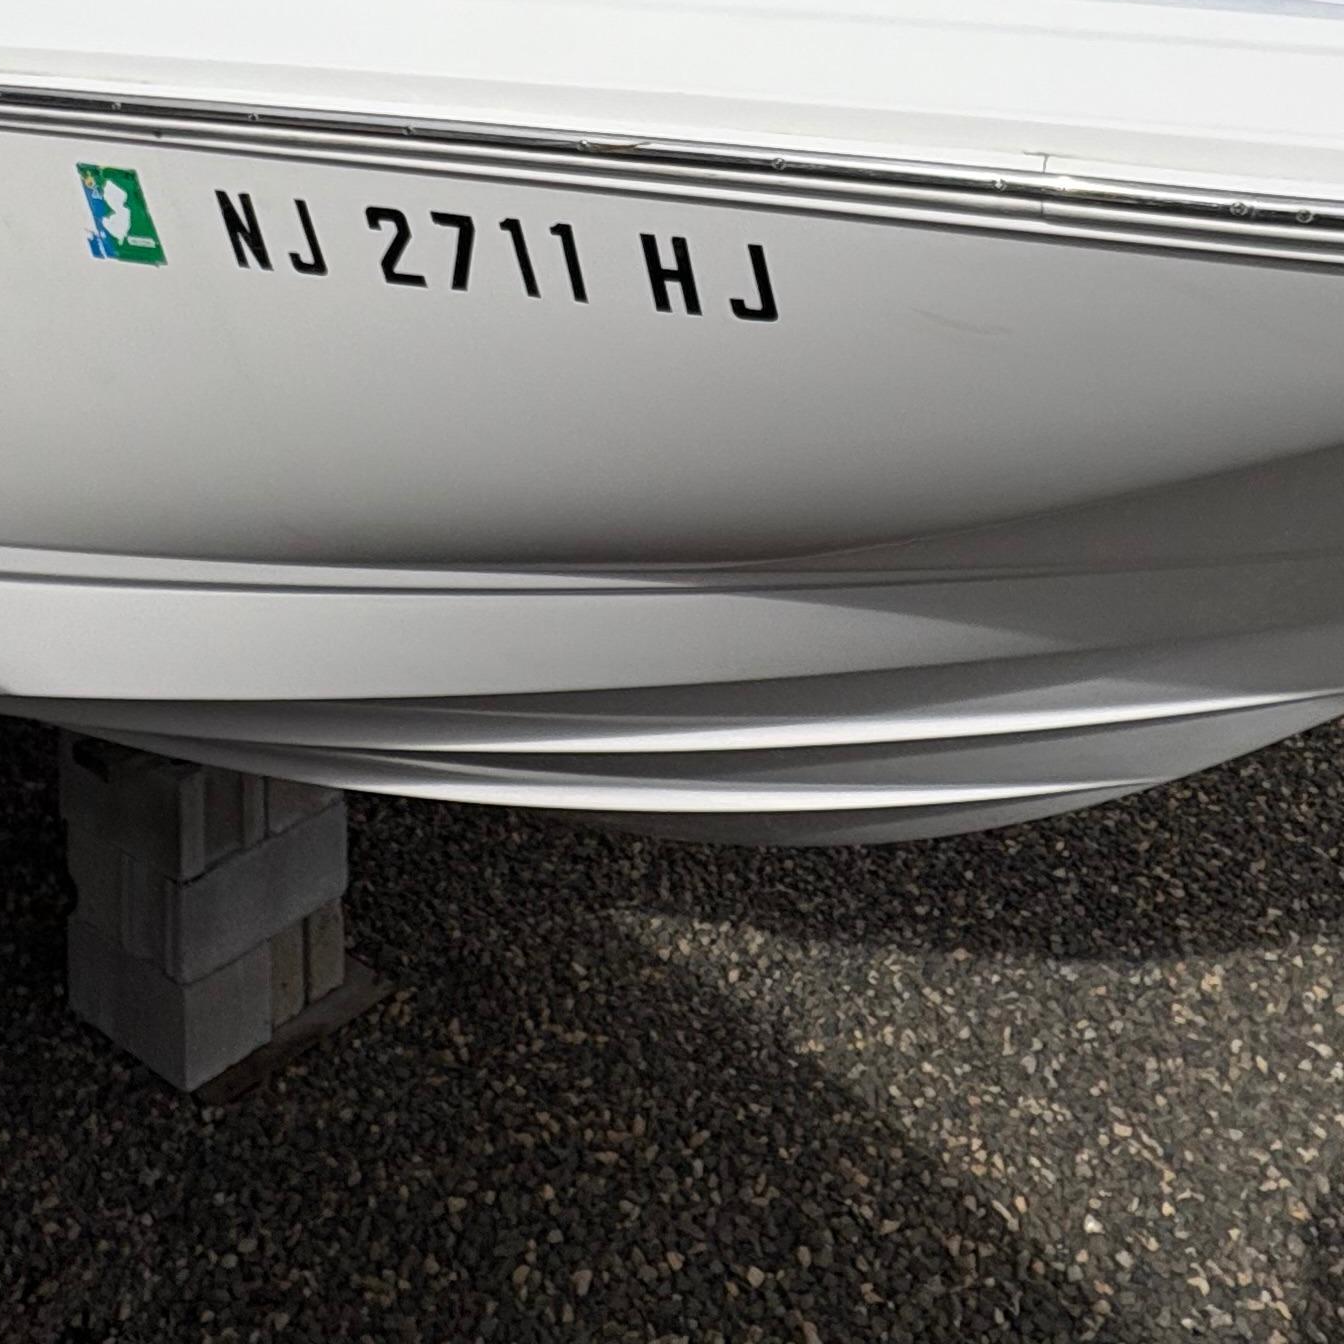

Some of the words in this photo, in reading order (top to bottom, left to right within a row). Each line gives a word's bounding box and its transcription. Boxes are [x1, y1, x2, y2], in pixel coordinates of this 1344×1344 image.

[215, 190, 327, 276] NJ
[365, 206, 588, 303] 2711
[639, 233, 779, 322] HJ
